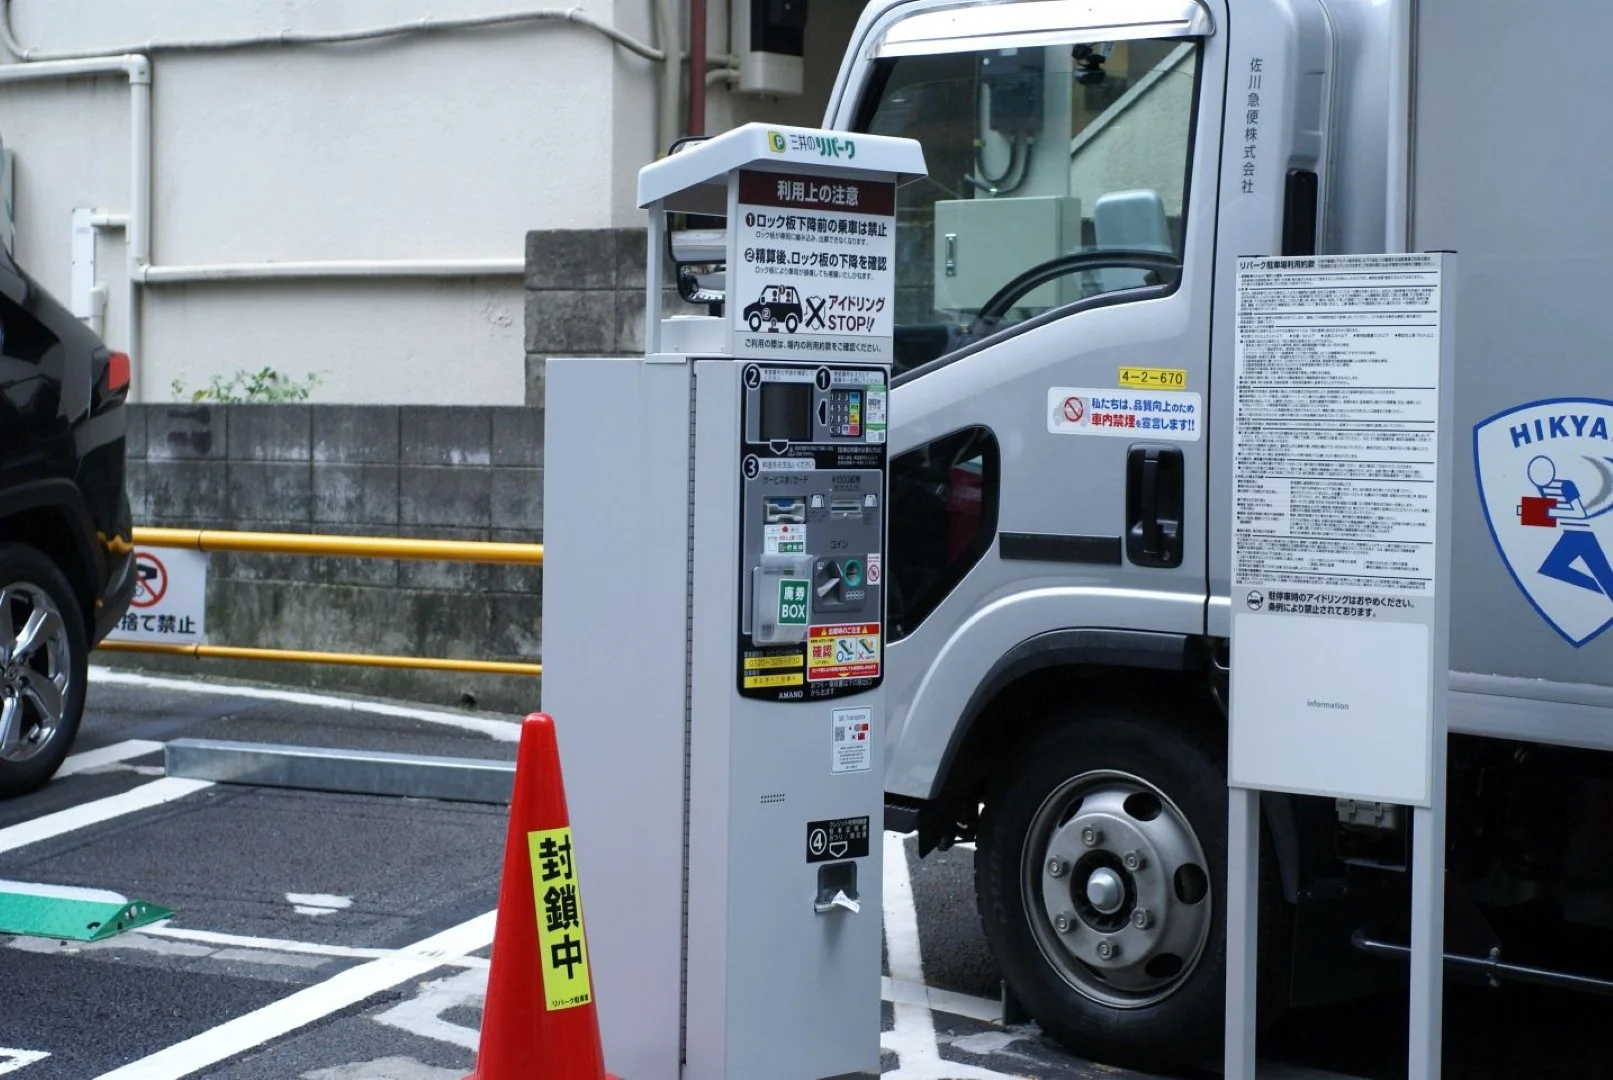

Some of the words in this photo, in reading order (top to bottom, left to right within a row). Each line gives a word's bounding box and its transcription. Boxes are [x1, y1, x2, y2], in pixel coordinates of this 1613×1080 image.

[1241, 57, 1263, 194] 佐川急便株式会社
[790, 133, 856, 160] 三井のリパーク
[777, 180, 859, 207] 利用上の注意
[757, 214, 887, 238] ロック板下降前の乗車は禁止
[828, 294, 886, 313] アイドリング
[1122, 370, 1183, 385] 4-2-670
[1091, 397, 1195, 414] 私たちは、品質向上のため
[1509, 414, 1613, 448] HIKYA
[831, 540, 849, 549] コイン
[1268, 590, 1415, 608] 駐停車時のアイドリングはおやめください。
[781, 604, 806, 619] BOX
[1268, 602, 1376, 618] 条例により禁止されております。
[114, 612, 196, 634] 捨て禁止
[812, 644, 833, 659] 確認
[1306, 699, 1350, 710] information
[538, 834, 583, 980] 封鎖中
